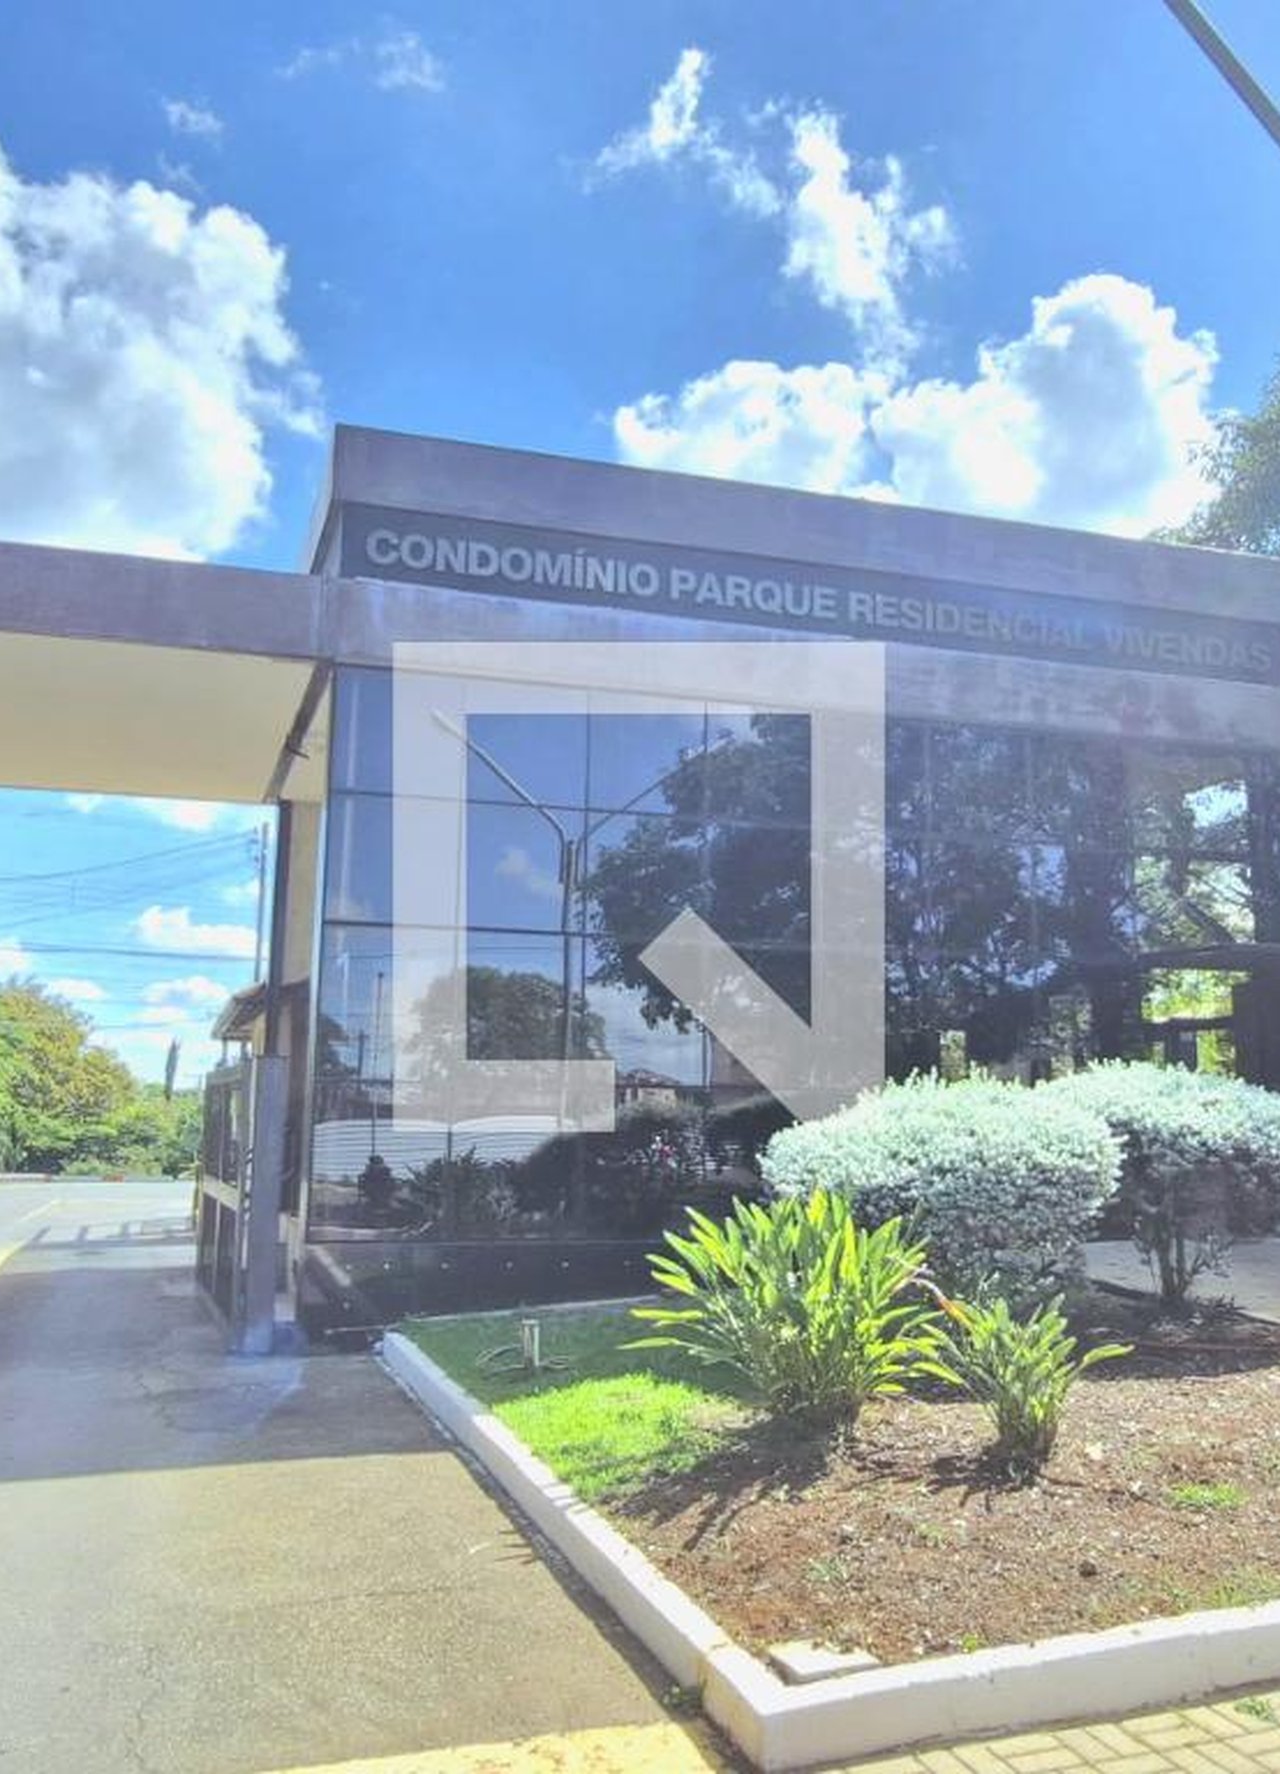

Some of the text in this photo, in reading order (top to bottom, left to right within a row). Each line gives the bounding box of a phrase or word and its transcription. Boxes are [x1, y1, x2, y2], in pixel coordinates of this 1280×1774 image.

[365, 528, 1273, 672] CONDOMÍNIO PARQUE RESIDENCIAL VIVENDAS
